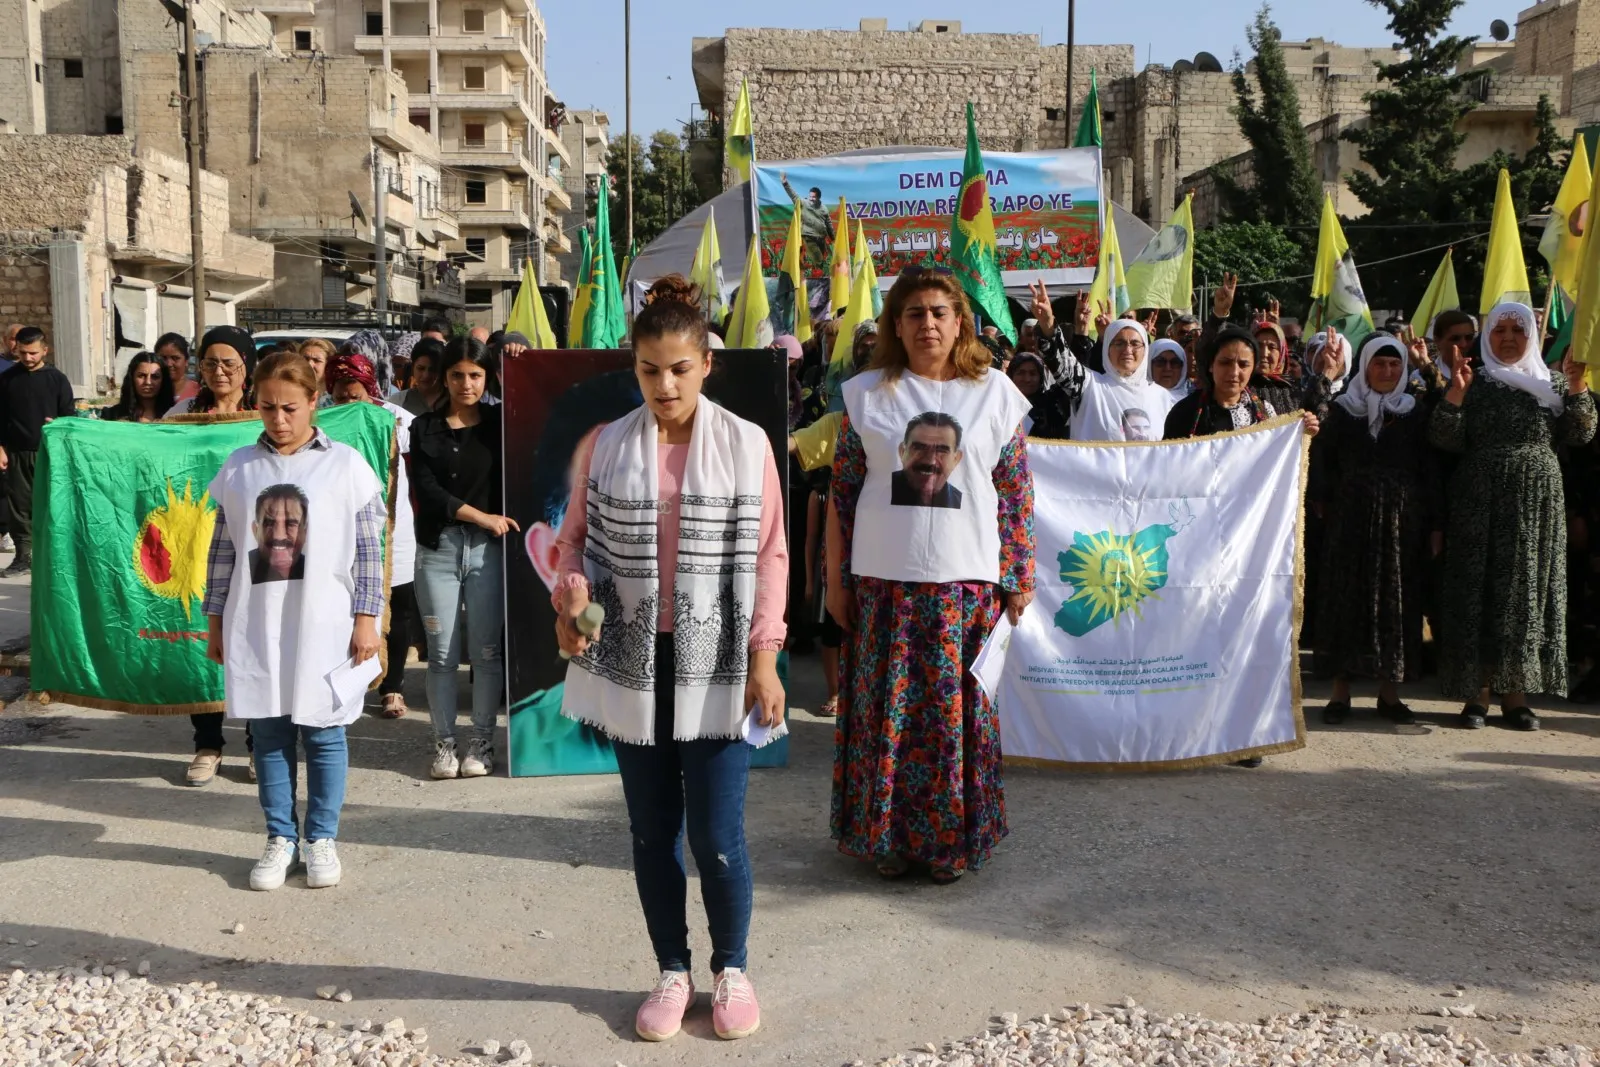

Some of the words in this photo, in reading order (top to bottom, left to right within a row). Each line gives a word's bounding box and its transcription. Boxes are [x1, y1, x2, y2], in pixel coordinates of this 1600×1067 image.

[899, 172, 944, 190] DEM
[949, 169, 1009, 188] DA
[845, 199, 930, 219] AZADIYA
[935, 195, 997, 215] RÊR
[1002, 194, 1044, 212] APO
[1048, 193, 1073, 210] YE
[893, 231, 937, 251] القائد
[1027, 226, 1060, 250] حان
[1019, 674, 1057, 684] INITIATIVE
[1194, 672, 1217, 681] SYRIA
